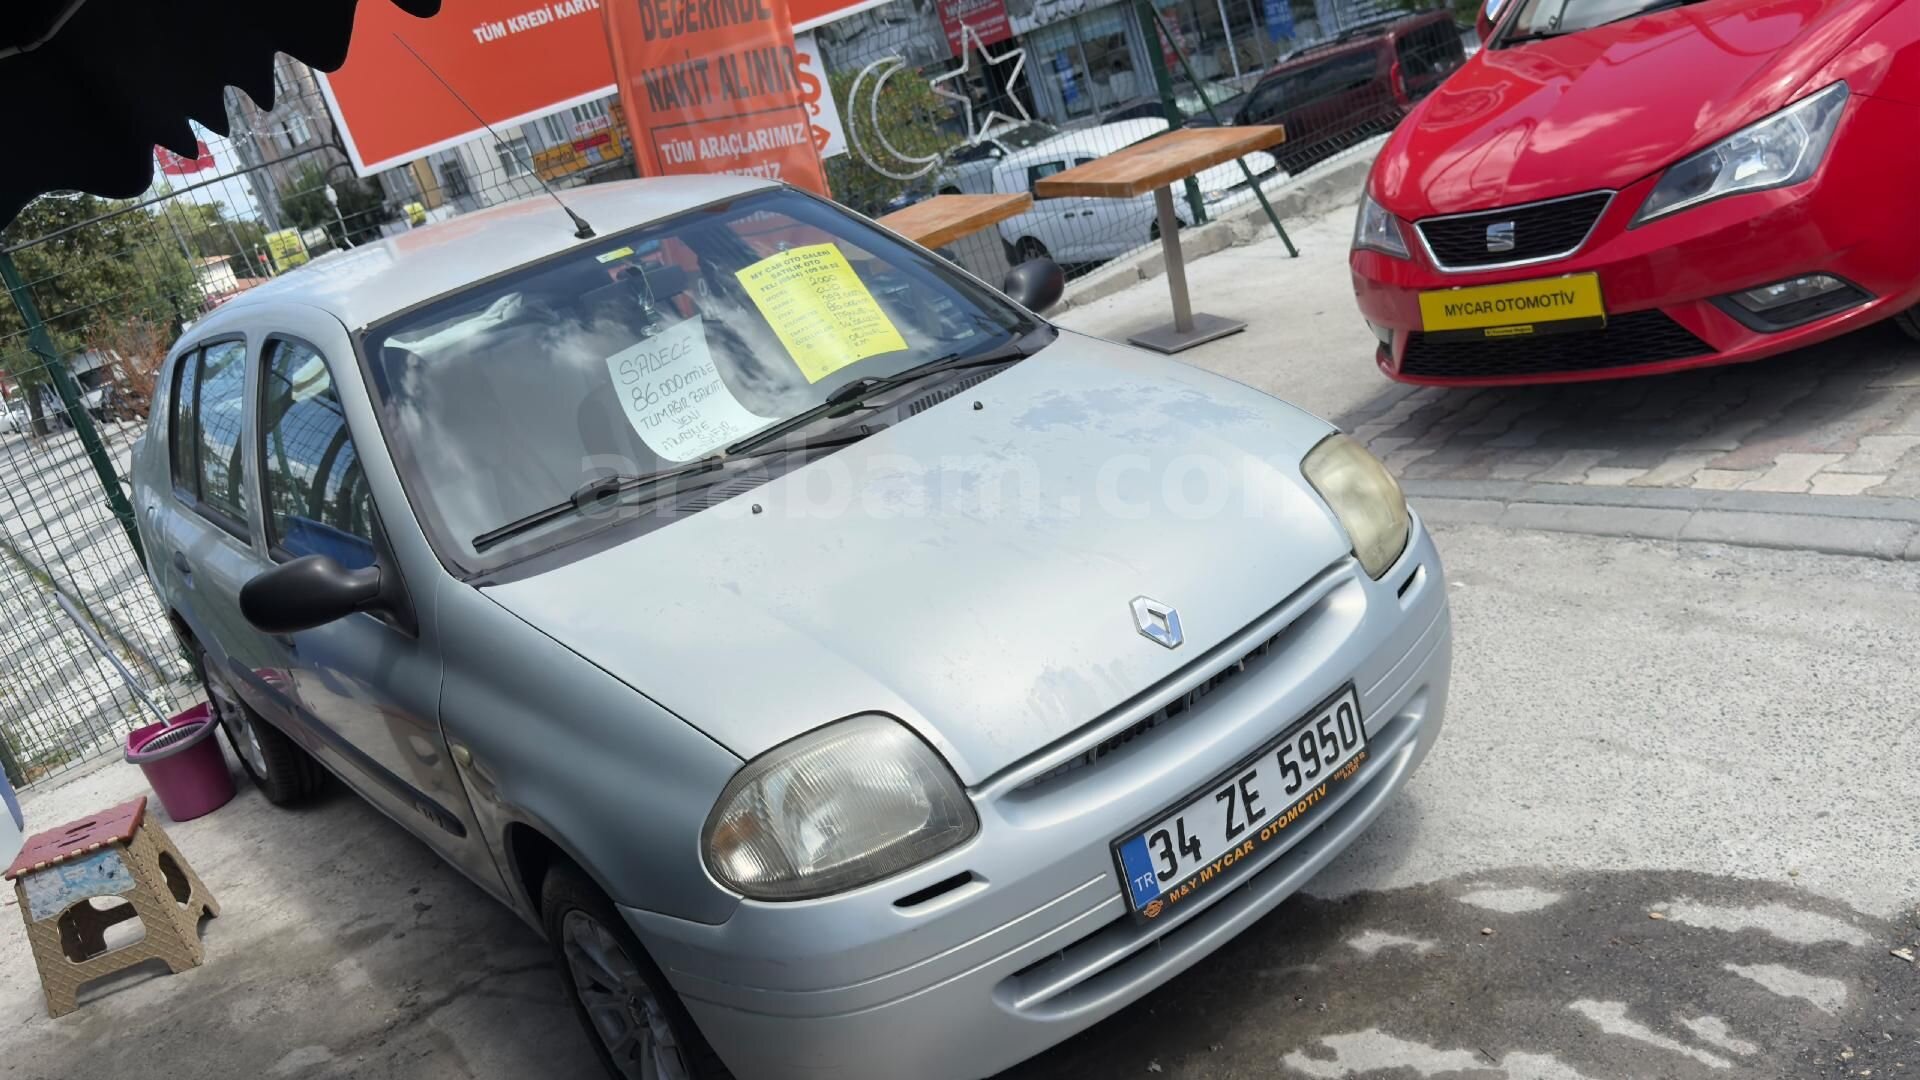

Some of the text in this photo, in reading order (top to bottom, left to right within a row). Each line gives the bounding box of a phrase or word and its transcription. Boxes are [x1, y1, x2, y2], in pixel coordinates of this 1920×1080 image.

[473, 20, 507, 44] TÜM
[507, 8, 555, 35] KREDİ
[642, 45, 802, 112] NAKİT ALINIR
[661, 122, 808, 165] TÜM ARAÇLARIMIZ
[1444, 290, 1576, 317] MYCAR OTOMOTİV
[619, 336, 693, 386] SADECE
[1135, 872, 1154, 892] TR
[1149, 817, 1202, 882] 34
[1216, 769, 1266, 842] ZE
[1277, 701, 1357, 795] 5950
[1169, 877, 1197, 903] M&Y
[1200, 840, 1255, 883] MYCAR
